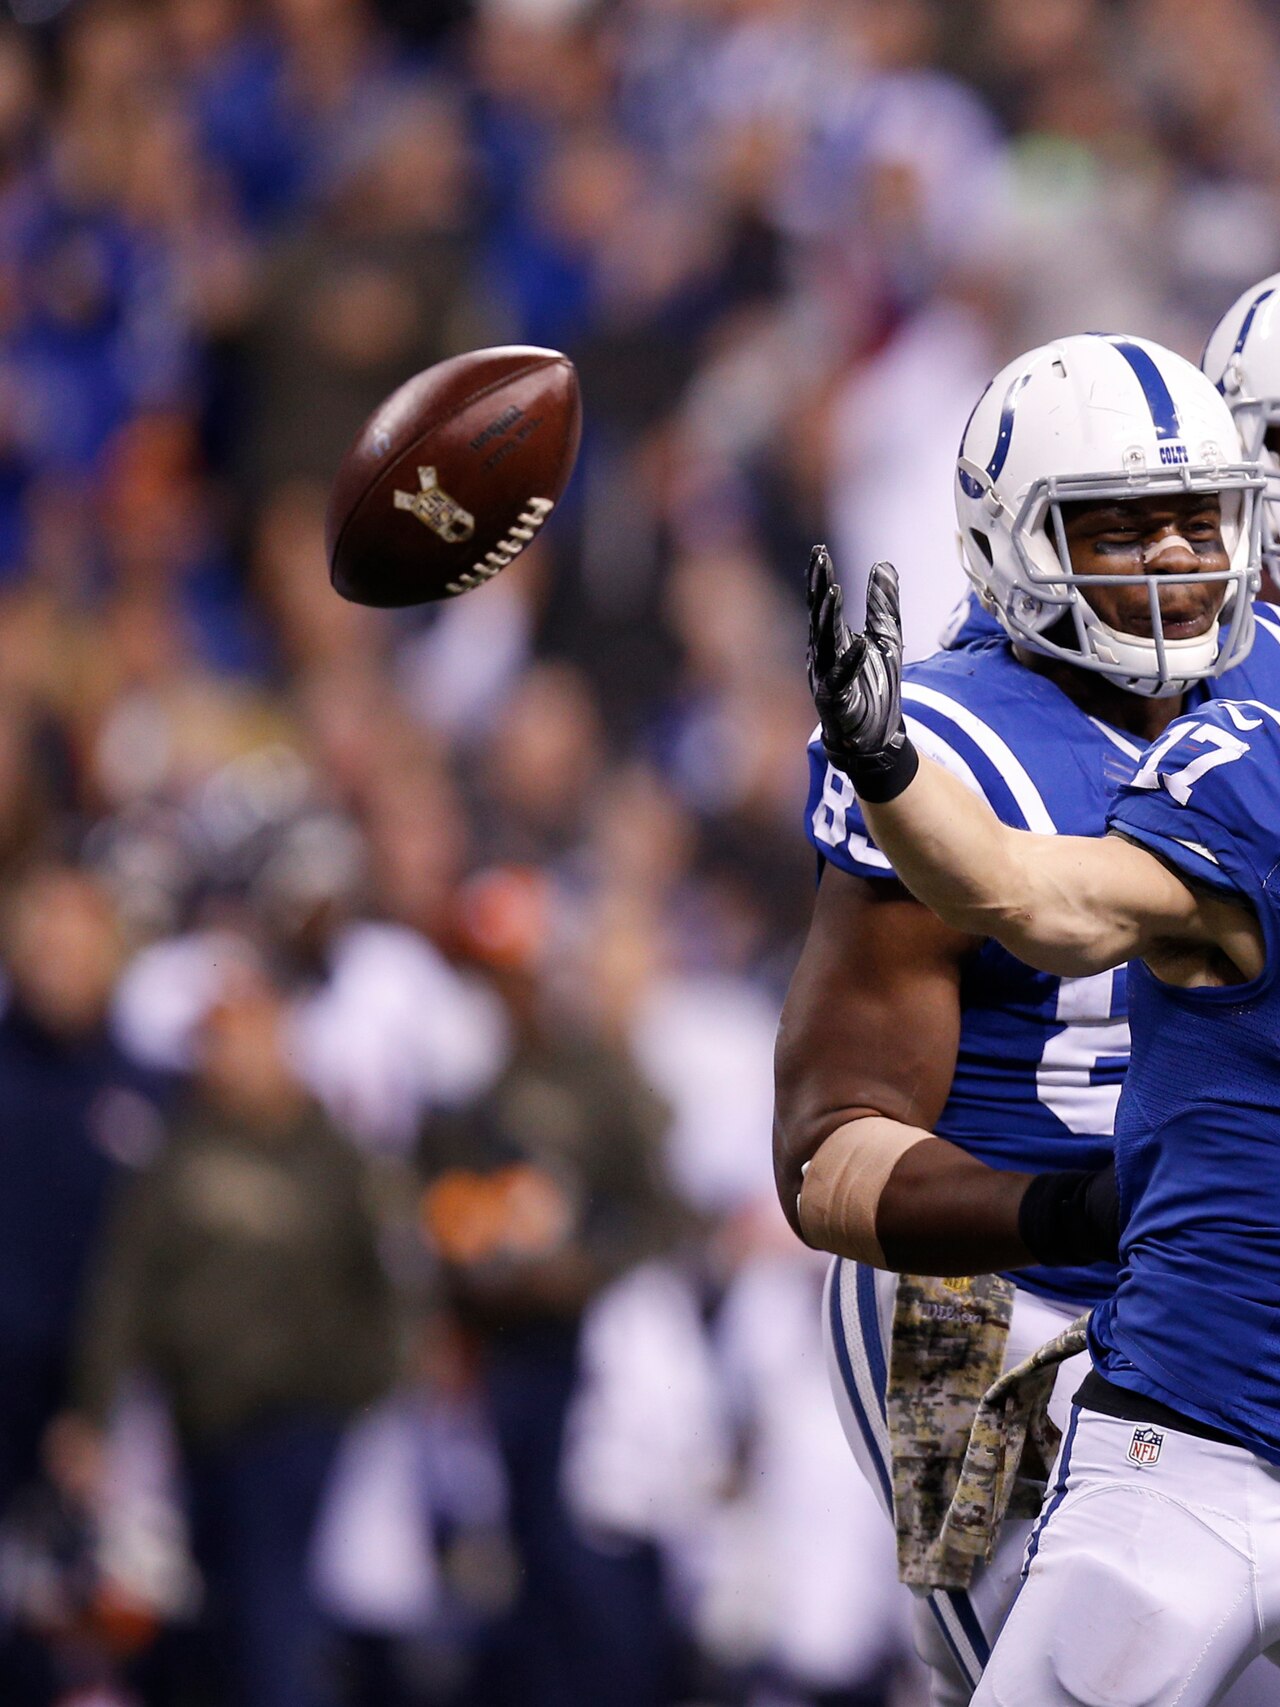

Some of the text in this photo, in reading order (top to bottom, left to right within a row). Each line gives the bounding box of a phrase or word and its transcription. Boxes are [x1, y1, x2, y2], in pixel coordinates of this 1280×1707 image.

[1159, 445, 1189, 464] COLTS
[1130, 721, 1250, 806] 17
[1132, 1441, 1156, 1462] NFL
